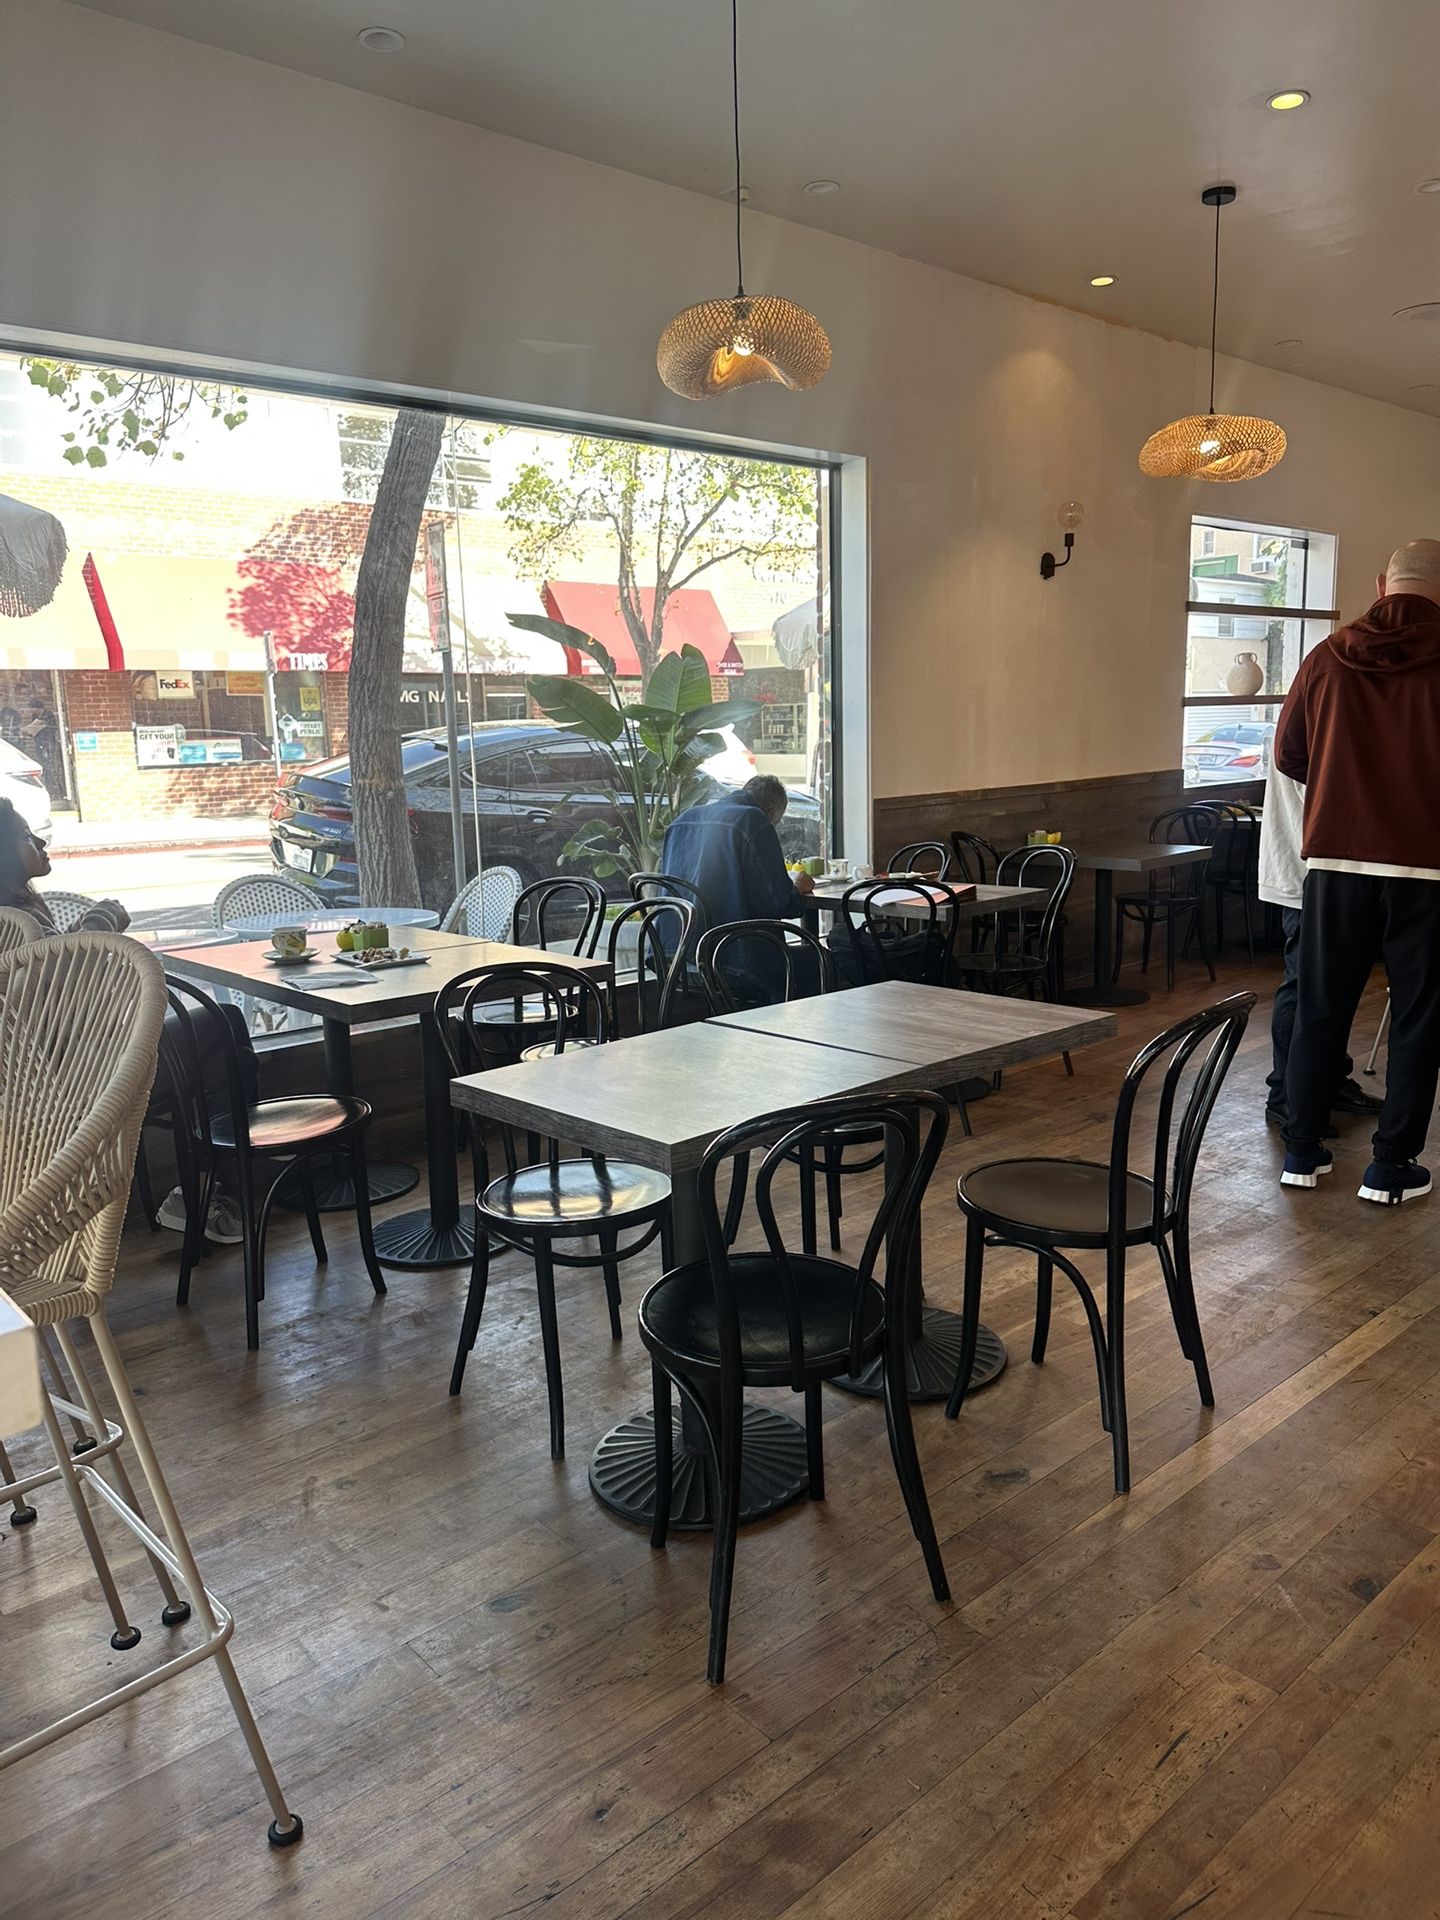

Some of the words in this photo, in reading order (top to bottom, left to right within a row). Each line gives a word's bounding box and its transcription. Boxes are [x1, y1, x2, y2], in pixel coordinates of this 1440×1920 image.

[289, 652, 328, 671] TIMES
[160, 679, 190, 689] FedEx
[400, 690, 419, 703] MG
